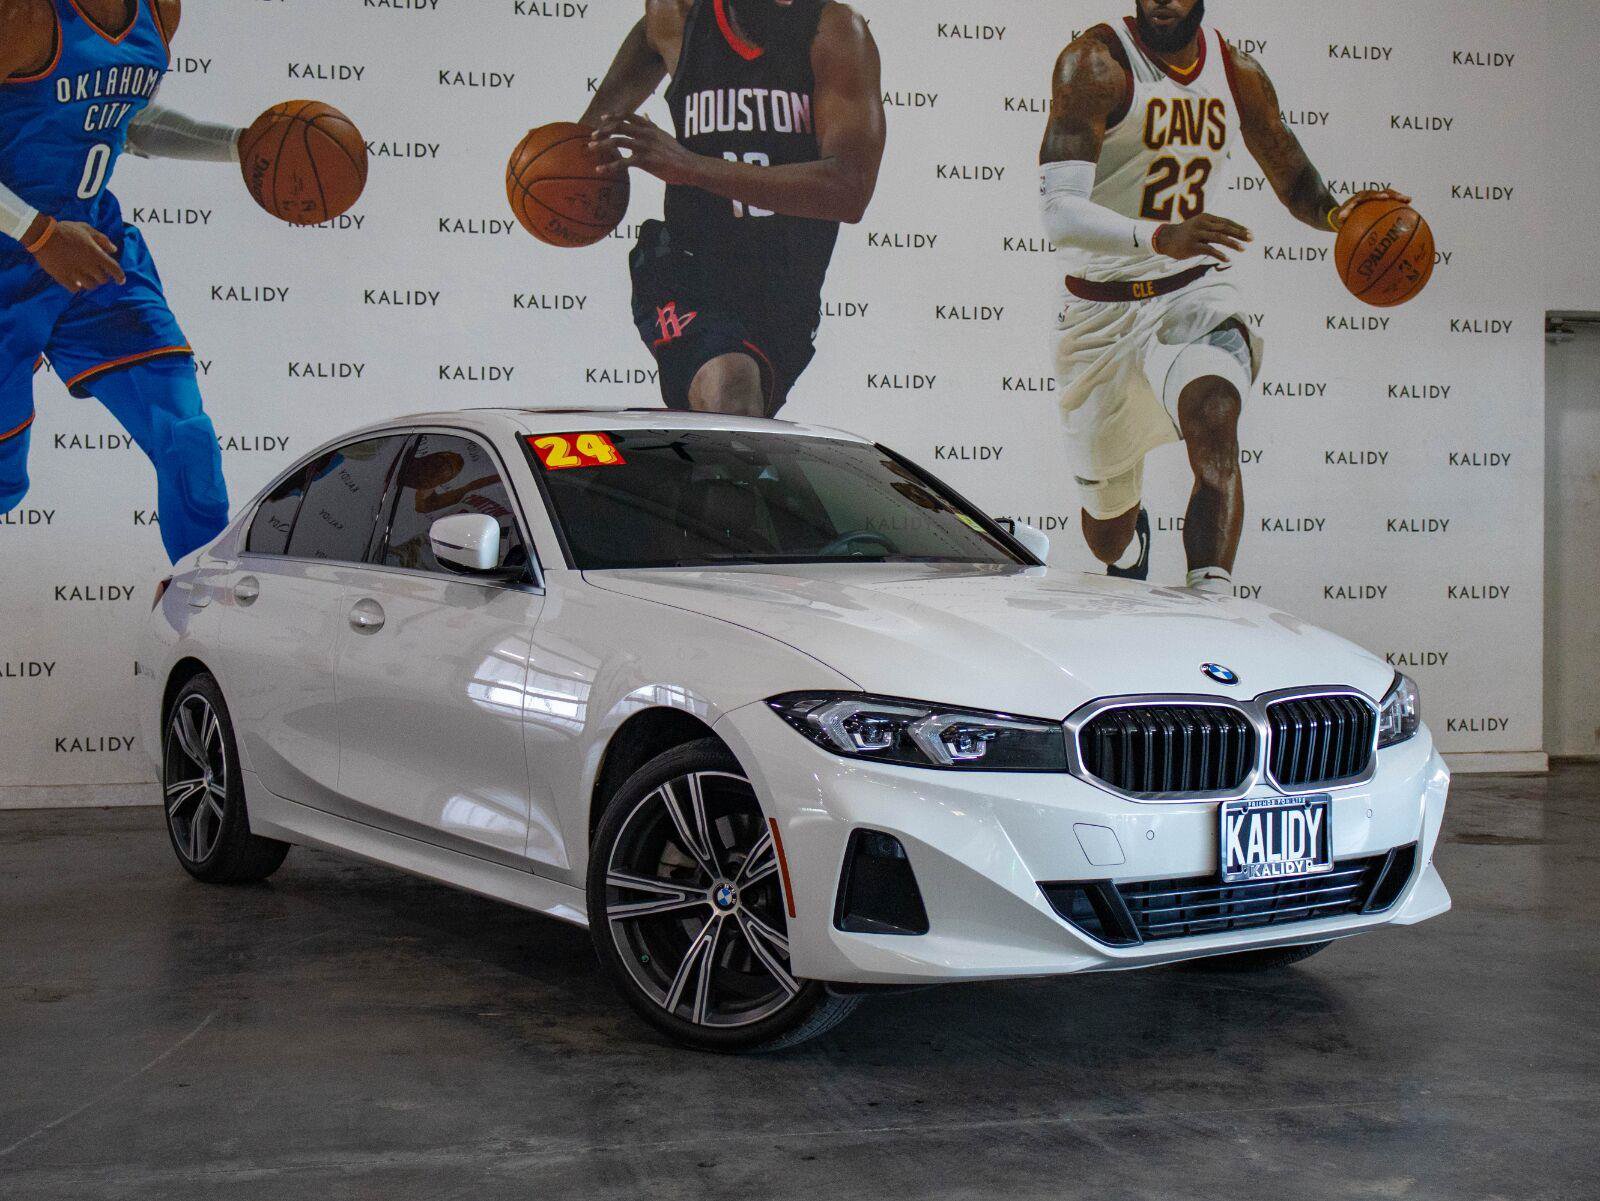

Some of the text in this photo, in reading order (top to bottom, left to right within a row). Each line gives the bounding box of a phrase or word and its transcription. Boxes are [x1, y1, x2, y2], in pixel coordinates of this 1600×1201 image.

[514, 1, 588, 18] KALIDY
[938, 23, 1006, 40] KALIDY
[1329, 45, 1392, 60] KALIDY
[1453, 51, 1515, 67] KALIDY
[168, 57, 211, 73] IDY
[288, 63, 365, 81] KALIDY
[57, 67, 158, 102] OKLAHOM
[439, 70, 515, 88] KALIDY
[881, 92, 938, 107] ALIDY
[1005, 97, 1054, 112] KALI
[84, 103, 131, 131] CITY
[685, 88, 811, 138] HOUSTON
[1279, 110, 1329, 126] ALIDY
[1143, 98, 1226, 150] CAVS
[1391, 115, 1453, 131] KALIDY
[365, 141, 440, 158] KALIDY
[77, 143, 111, 199] 0
[937, 164, 1005, 180] KALIDY
[1139, 154, 1212, 222] 23
[1228, 175, 1265, 190] IDY
[1452, 185, 1513, 200] KALIDY
[133, 208, 211, 225] KALIDY
[439, 218, 514, 235] KALIDY
[869, 232, 937, 248] KALIDY
[1003, 237, 1056, 252] KALI
[1264, 246, 1328, 262] KALIDY
[211, 285, 289, 302] KALIDY
[1132, 280, 1155, 298] CLE
[364, 290, 440, 306] KALIDY
[514, 294, 587, 310] KALIDY
[820, 302, 869, 317] LIDY
[936, 305, 1004, 320] KALIDY
[1327, 316, 1390, 330] KALIDY
[1451, 319, 1512, 333] KALIDY
[289, 362, 365, 378] KALIDY
[439, 365, 514, 381] KALIDY
[586, 368, 658, 385] KALIDY
[868, 374, 936, 389] KALIDY
[1003, 377, 1055, 391] KALID
[1262, 382, 1327, 397] KALIDY
[1388, 385, 1451, 399] KALIDY
[55, 434, 133, 449] KALIDY
[534, 434, 618, 467] 24
[935, 446, 1003, 460] KALIDY
[1325, 451, 1388, 465] KALIDY
[1449, 452, 1511, 466] KALIDY
[0, 510, 56, 525] LIDY
[1262, 518, 1325, 532] KALIDY
[1387, 519, 1449, 532] KALIDY
[55, 586, 134, 601] KALIDY
[1324, 585, 1387, 599] KALIDY
[1448, 585, 1510, 599] KALIDY
[1386, 652, 1448, 666] KALIDY
[0, 662, 56, 678] LIDY
[1447, 718, 1508, 732] KALIDY
[56, 736, 135, 752] KALIDY
[1227, 808, 1323, 867] KALIDY
[1250, 859, 1304, 878] KALIDY
